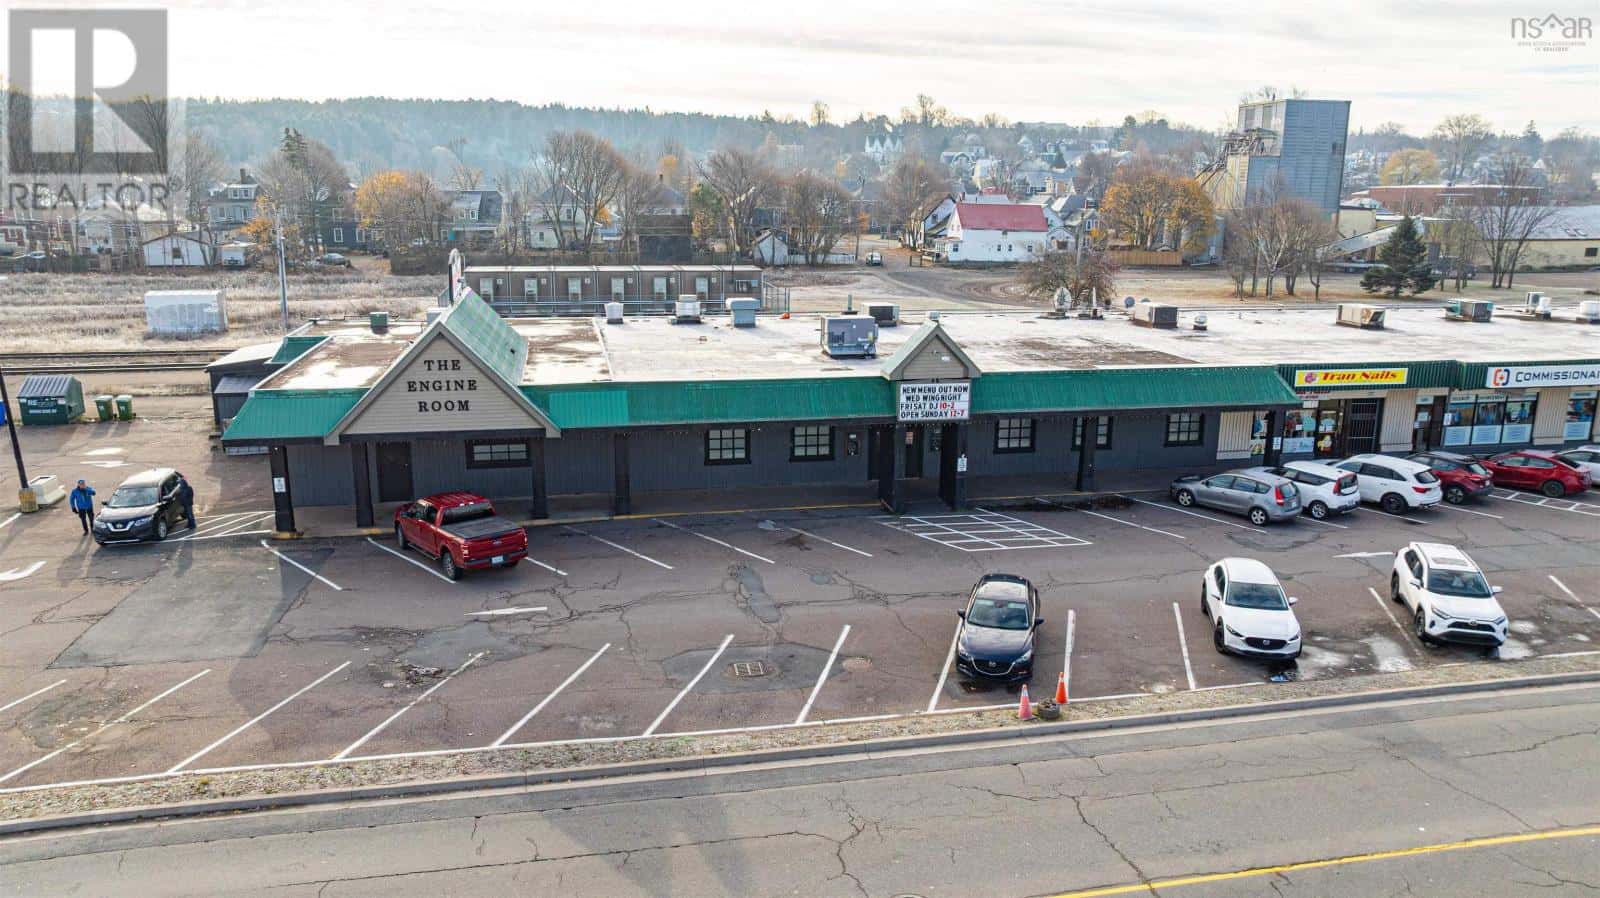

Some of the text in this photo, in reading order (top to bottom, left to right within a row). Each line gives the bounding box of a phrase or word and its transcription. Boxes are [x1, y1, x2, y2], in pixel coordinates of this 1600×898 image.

[424, 360, 461, 371] THE
[1322, 370, 1397, 380] Tran Nails
[407, 380, 477, 392] ENGINE
[902, 386, 917, 394] NEW
[938, 385, 952, 393] OUT
[905, 394, 921, 402] WED
[418, 400, 470, 412] ROOM
[920, 410, 948, 418] SUNDAY
